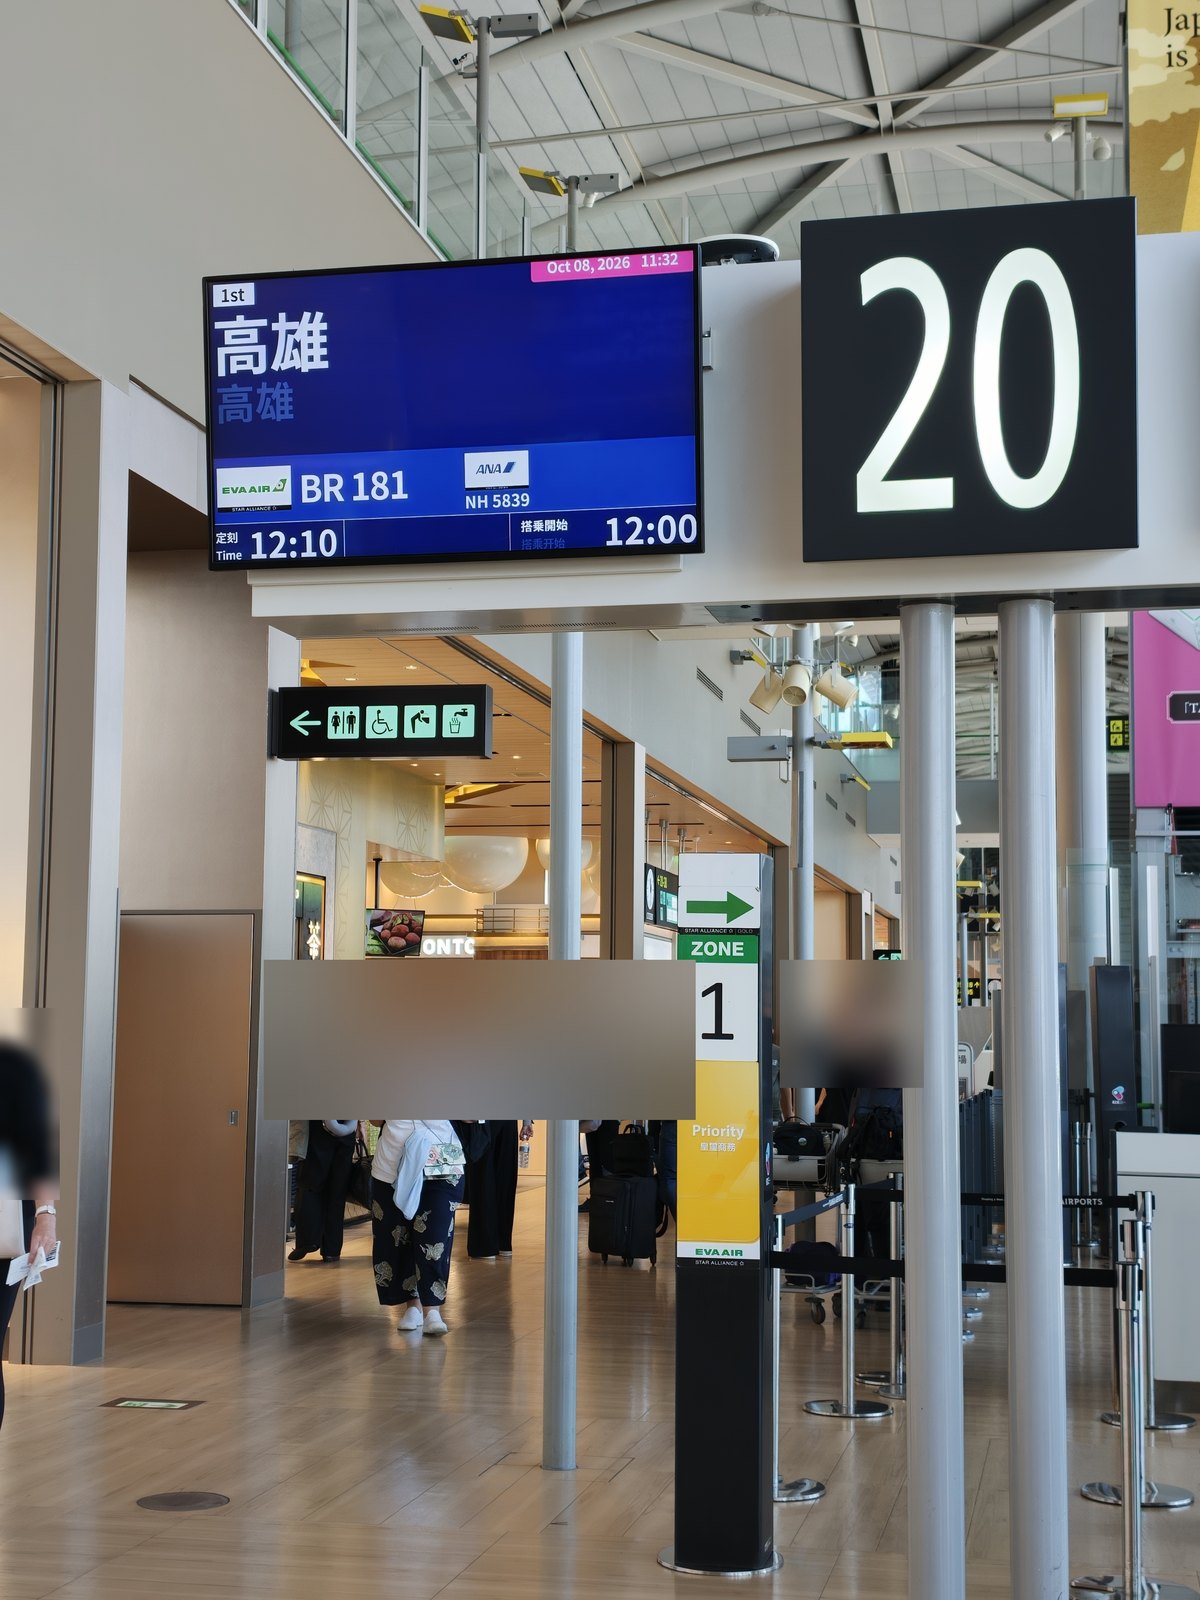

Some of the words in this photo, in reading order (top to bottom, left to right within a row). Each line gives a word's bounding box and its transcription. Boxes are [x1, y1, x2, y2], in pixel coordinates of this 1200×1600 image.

[1166, 44, 1188, 67] is
[547, 260, 571, 274] Oct
[574, 259, 594, 274] 08,
[597, 256, 631, 271] 2026
[641, 252, 678, 268] 11:32
[221, 288, 245, 303] 1st
[214, 311, 329, 377] 高雄
[856, 247, 1080, 512] 20
[216, 381, 294, 424] 高雄
[475, 463, 501, 475] ANA
[301, 473, 345, 504] BR
[352, 470, 409, 501] 181
[465, 494, 488, 509] NH
[492, 492, 530, 508] 5839
[520, 518, 568, 533] 搭乗開始
[605, 513, 697, 546] 12:00
[215, 531, 238, 545] 定刻
[250, 528, 338, 560] 12:10
[215, 550, 242, 561] Time
[691, 941, 744, 957] ZONE
[701, 982, 734, 1040] 1
[692, 1124, 744, 1141] Priority
